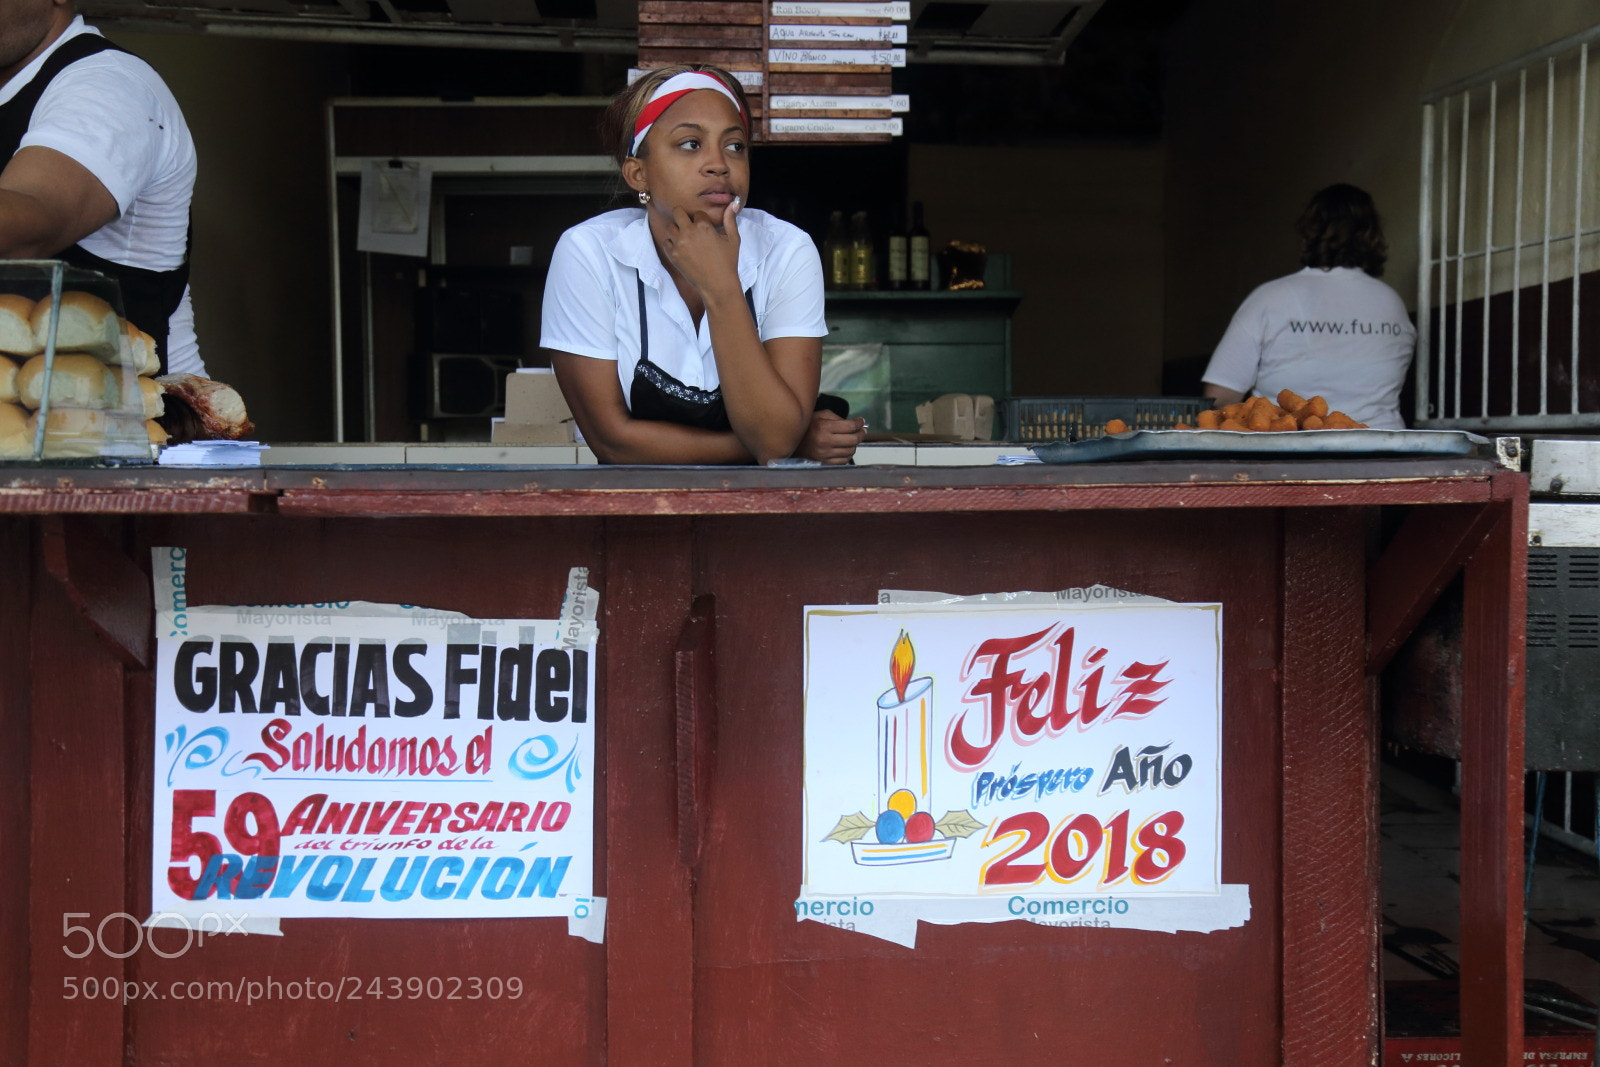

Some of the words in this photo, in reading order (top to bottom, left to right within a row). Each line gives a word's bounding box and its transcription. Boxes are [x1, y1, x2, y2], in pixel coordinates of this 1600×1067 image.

[1289, 319, 1402, 336] www.fu.no
[236, 609, 332, 628] Mayorista
[173, 634, 434, 718] GRACIAS
[945, 620, 1176, 771] Feliz
[242, 718, 463, 777] Saludamos
[465, 725, 493, 775] el
[973, 763, 1094, 808] Próspero
[1099, 741, 1193, 797] Año
[168, 789, 281, 900] 59
[280, 793, 572, 836] ANIVERSARIO
[191, 842, 573, 902] REVOLUCIÓN
[294, 838, 333, 850] del
[438, 836, 468, 851] de
[470, 836, 500, 850] la
[978, 808, 1187, 893] 2018
[1008, 895, 1129, 915] Comercio
[1416, 1052, 1461, 1061] LICORES
